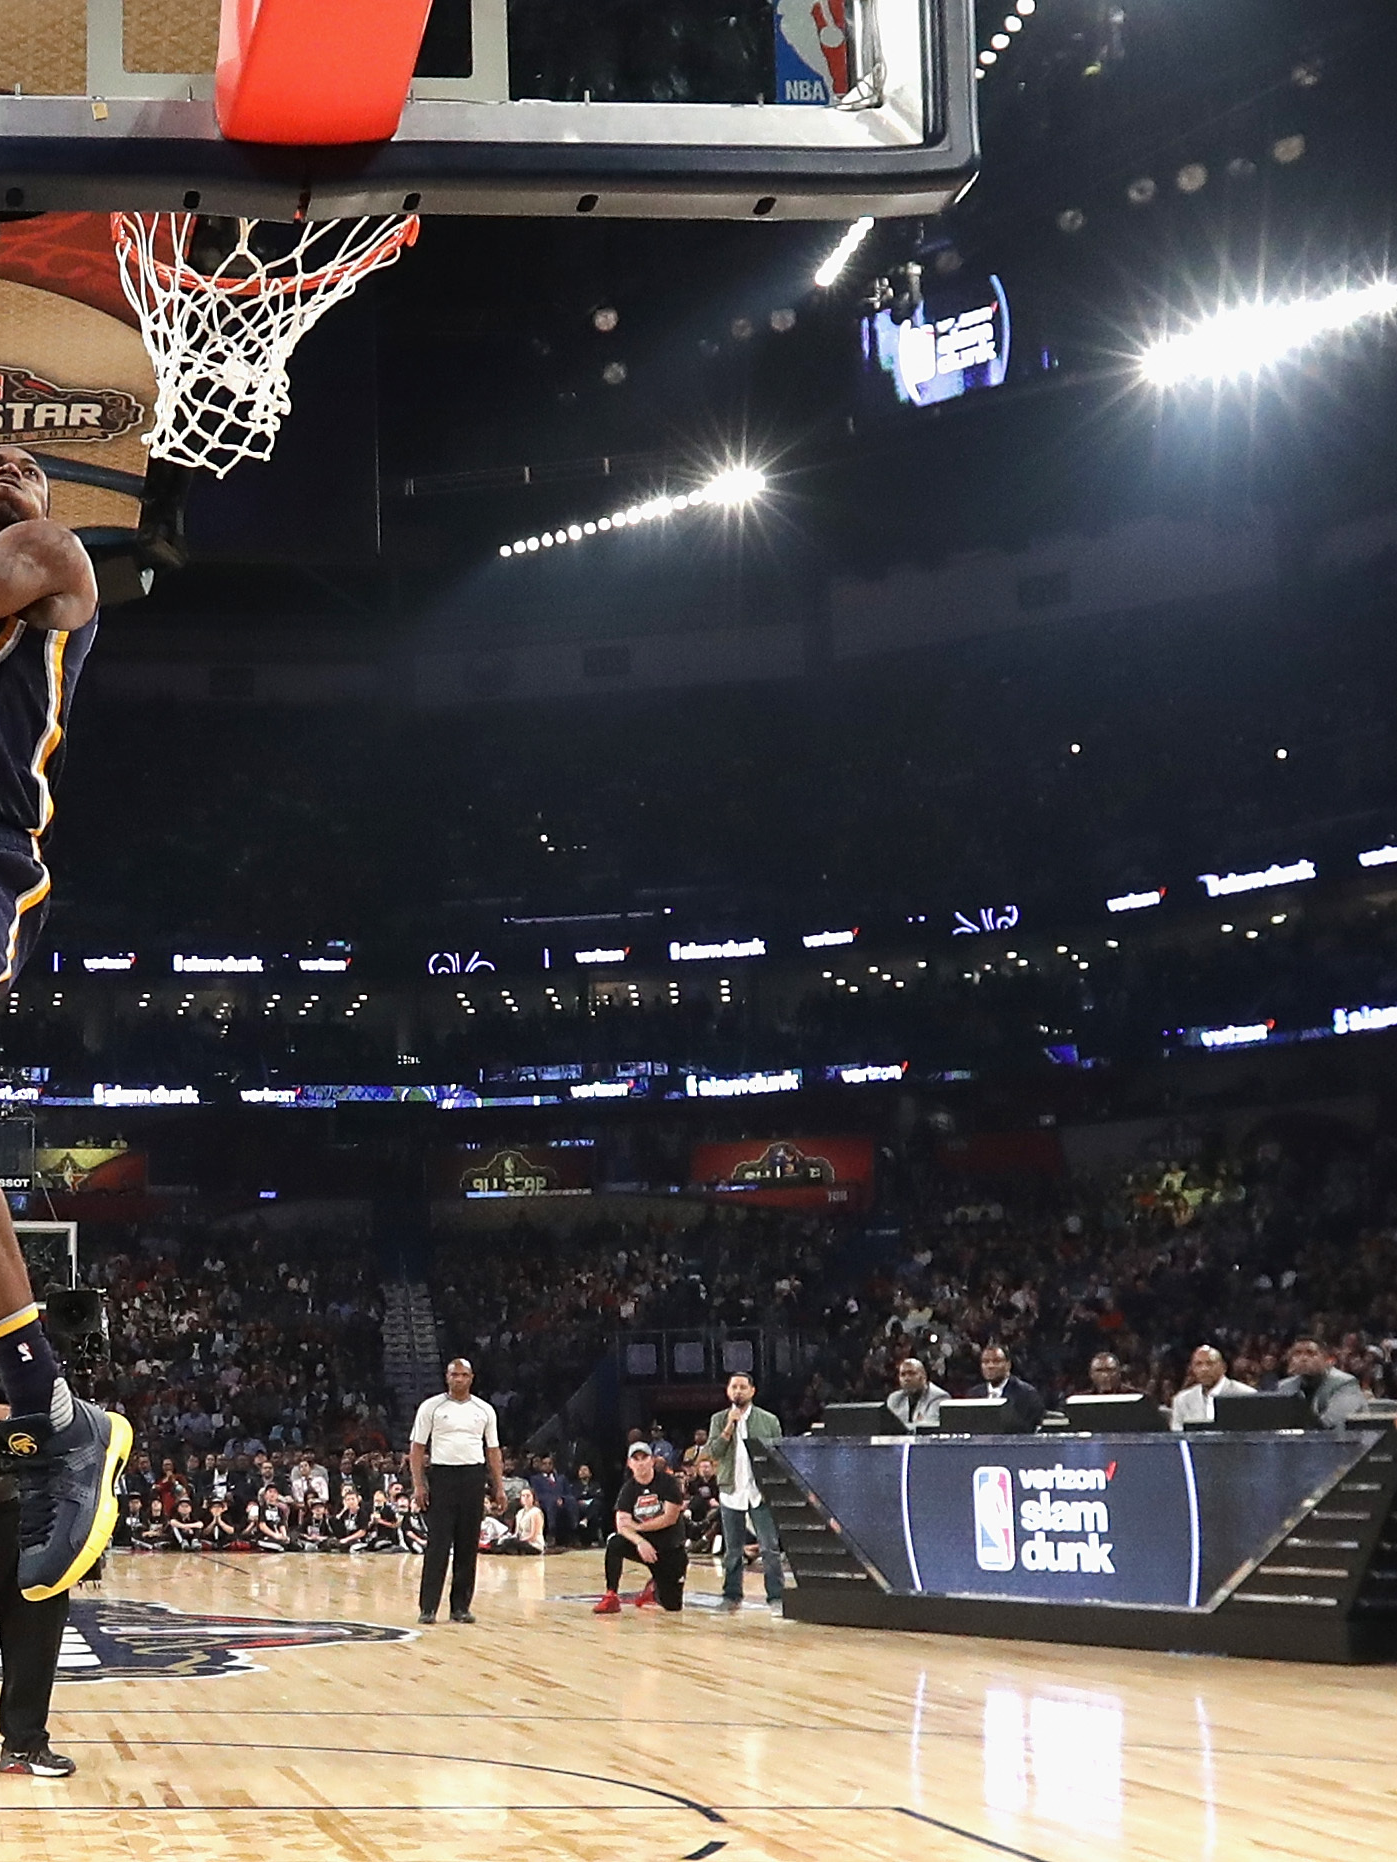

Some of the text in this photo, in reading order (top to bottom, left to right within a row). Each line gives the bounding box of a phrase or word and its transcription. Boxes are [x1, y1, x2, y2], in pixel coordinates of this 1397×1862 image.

[785, 79, 826, 101] NBA
[1019, 1463, 1107, 1491] verizon
[1020, 1491, 1109, 1532] slam
[1021, 1531, 1116, 1574] dunk
